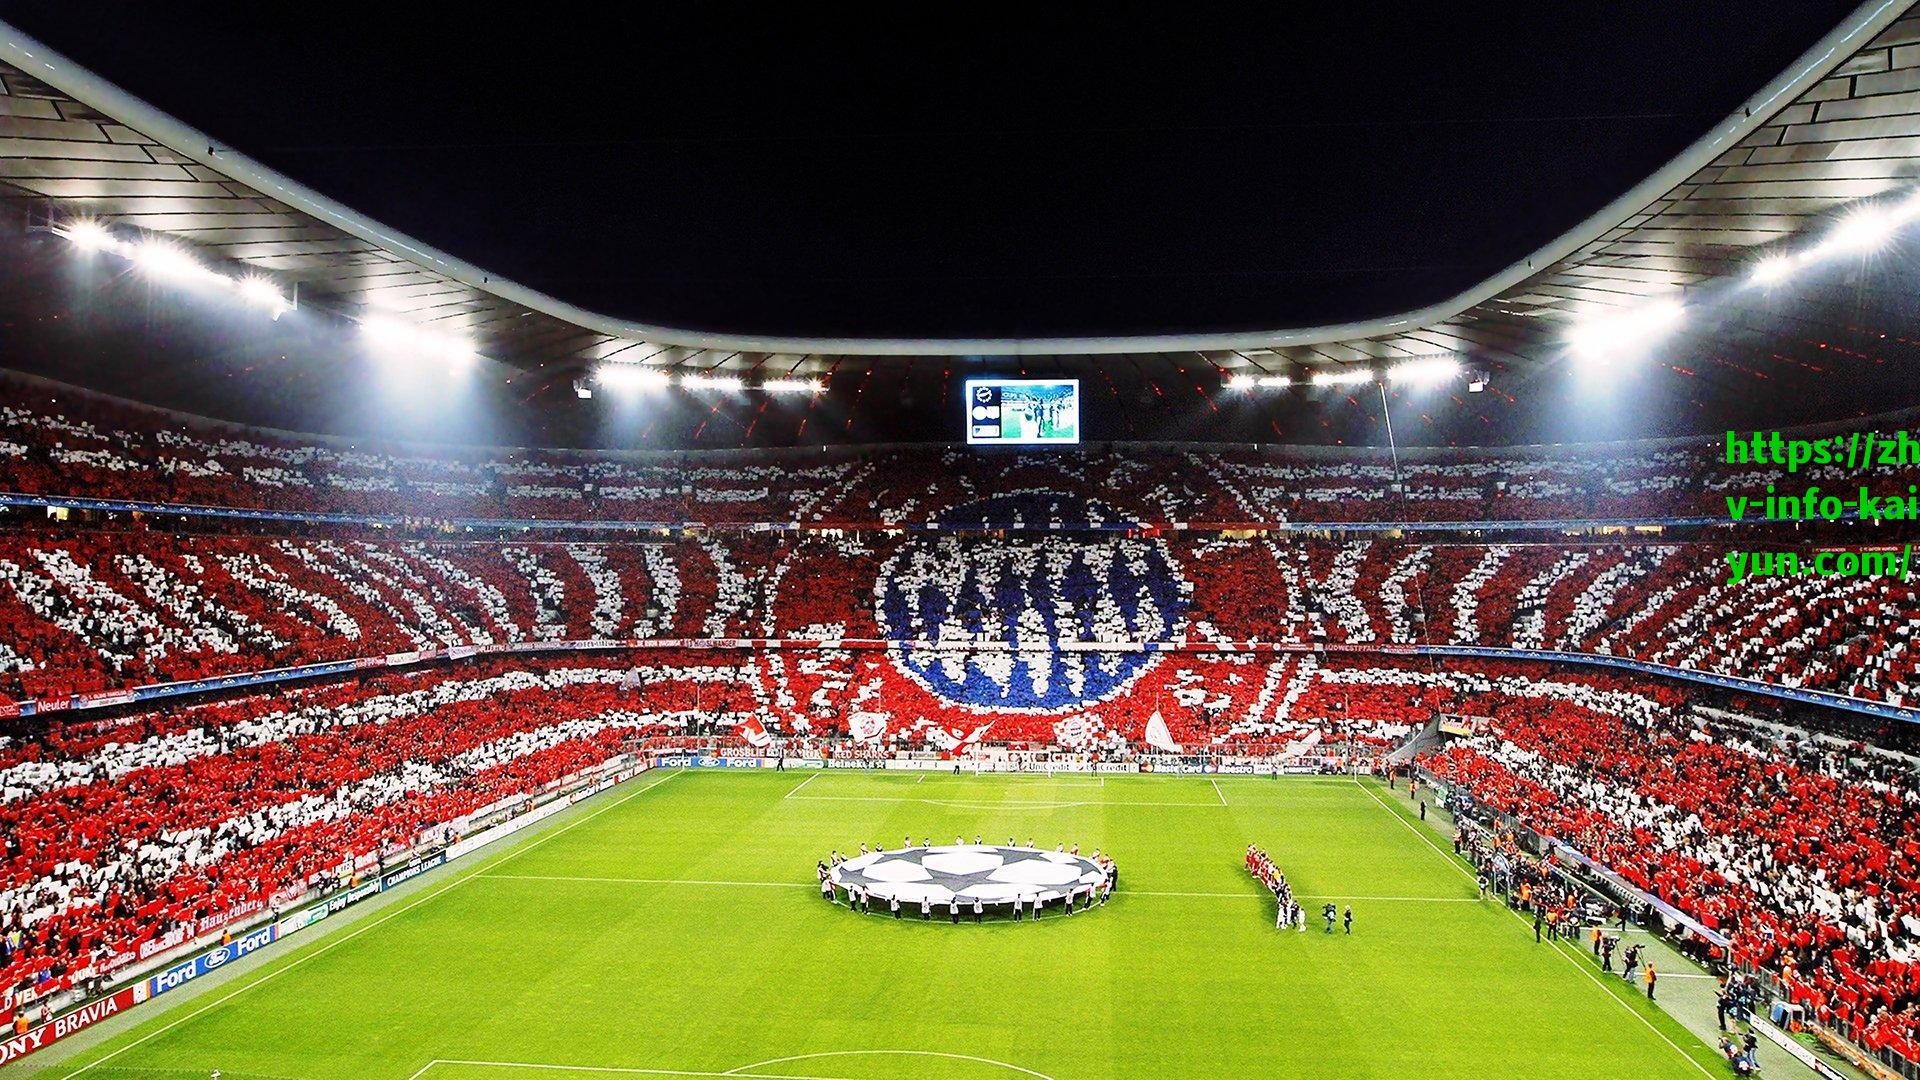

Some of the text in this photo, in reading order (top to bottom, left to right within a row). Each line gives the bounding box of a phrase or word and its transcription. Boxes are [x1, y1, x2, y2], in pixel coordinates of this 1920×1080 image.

[37, 699, 70, 712] Neuler
[854, 750, 889, 759] SHARKS
[661, 757, 692, 767] Ford
[726, 757, 757, 767] Ford
[1217, 765, 1253, 774] Maestro
[387, 864, 420, 886] CHAMPIONS
[421, 855, 441, 871] LEAGUE
[329, 898, 346, 911] Enjoy
[237, 928, 271, 956] Ford
[156, 959, 196, 993] Ford
[55, 997, 118, 1038] BRAVIA
